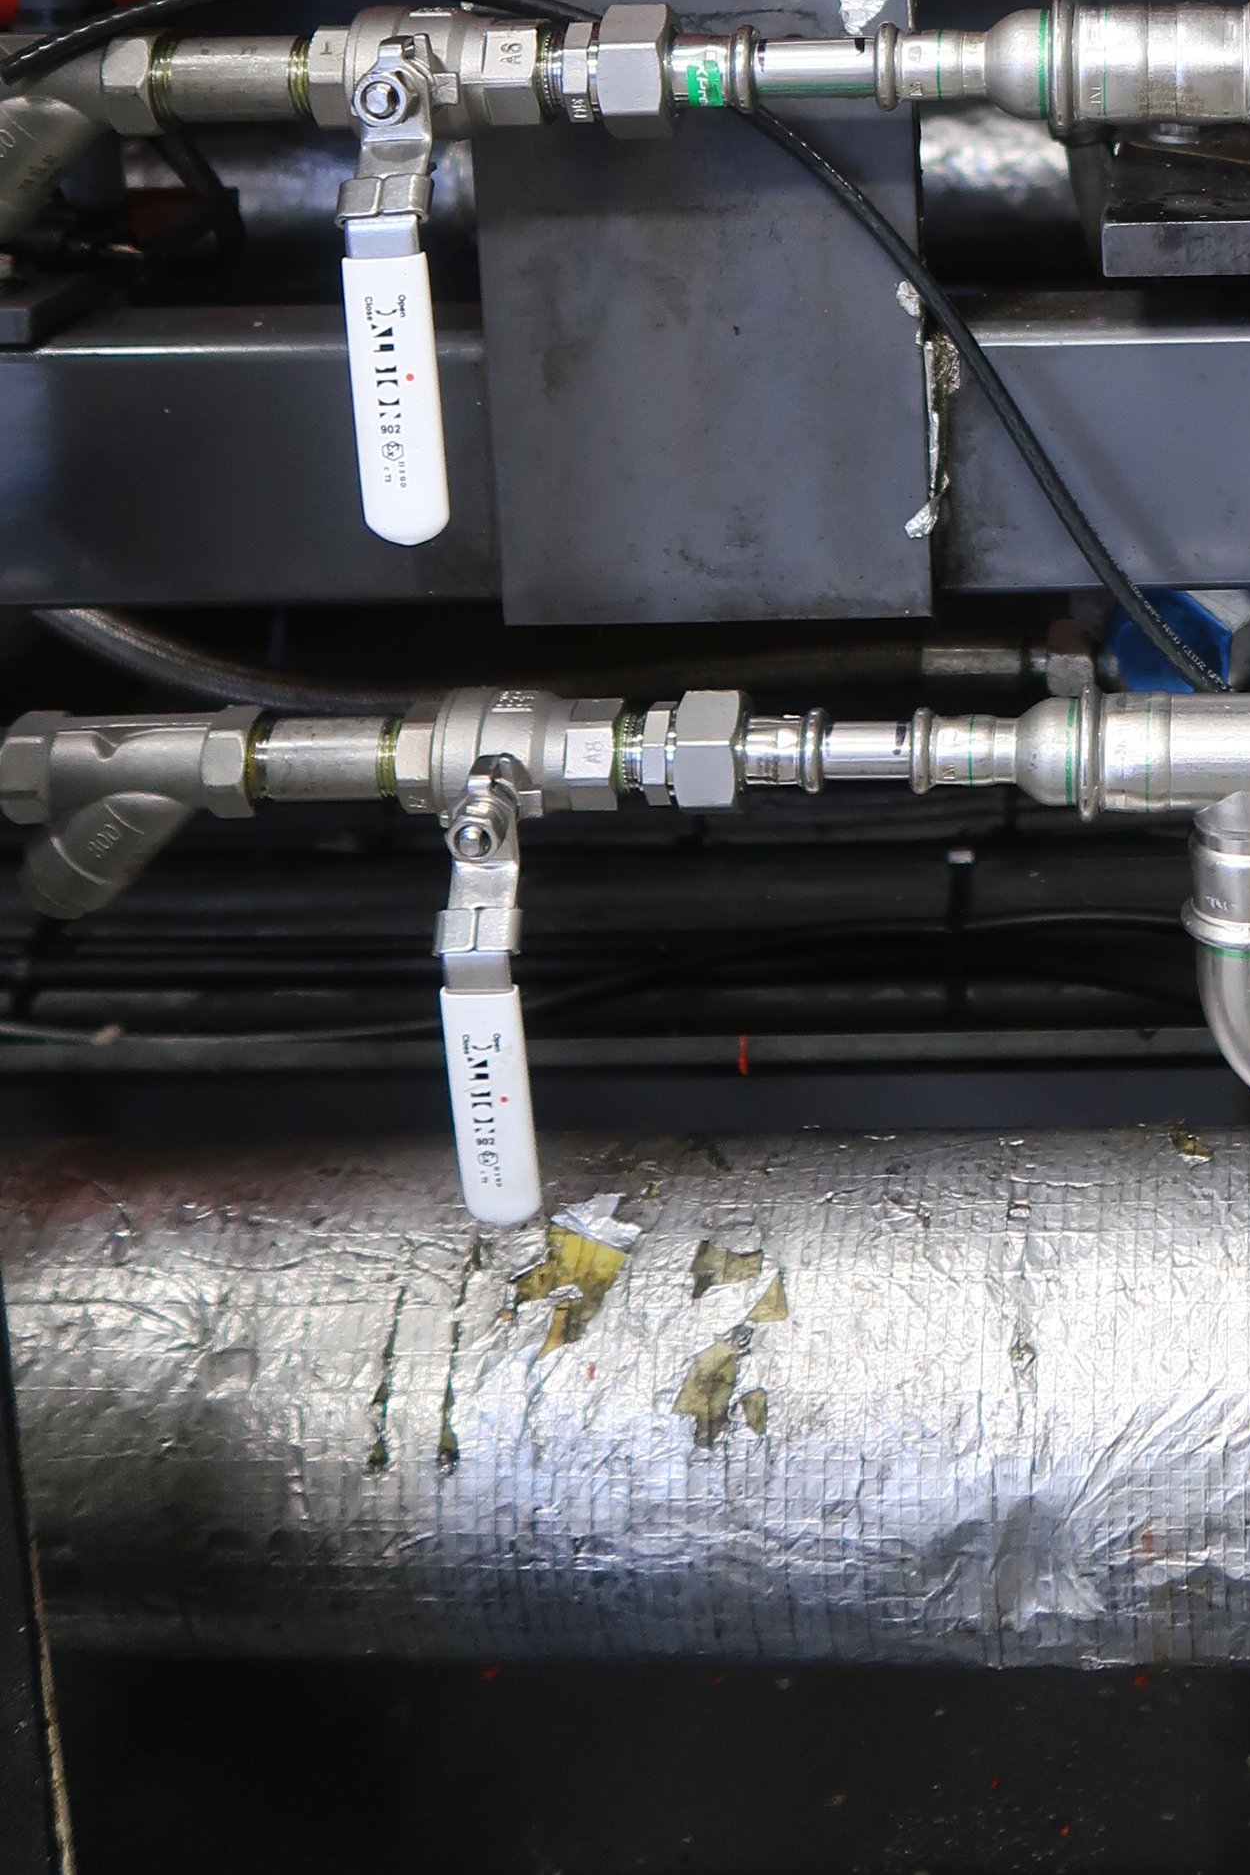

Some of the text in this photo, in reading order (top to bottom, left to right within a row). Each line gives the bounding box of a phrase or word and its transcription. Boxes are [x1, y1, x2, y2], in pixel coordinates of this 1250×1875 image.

[364, 296, 373, 321] Close
[398, 294, 407, 318] Open
[380, 424, 402, 435] 902
[475, 1137, 496, 1147] 902
